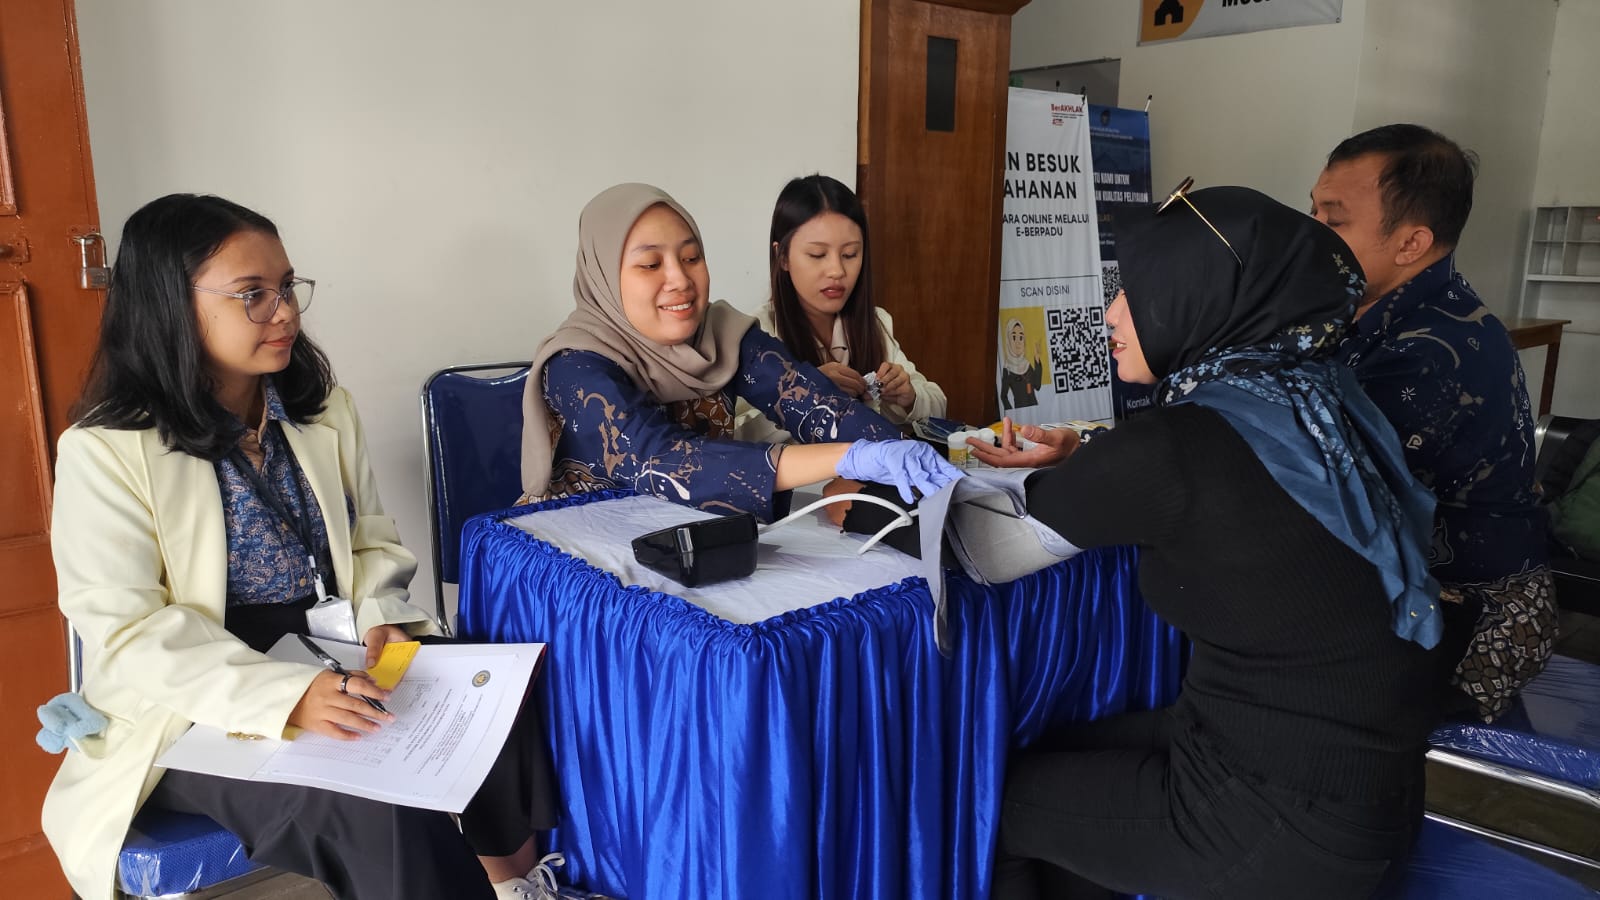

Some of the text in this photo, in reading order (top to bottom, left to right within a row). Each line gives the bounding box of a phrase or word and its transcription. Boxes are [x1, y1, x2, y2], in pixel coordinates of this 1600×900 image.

[1051, 104, 1083, 113] BerAKHLAK
[1005, 151, 1081, 173] N BESUK
[1004, 179, 1077, 199] AHANAN
[1021, 214, 1053, 224] ONLINE
[1054, 214, 1090, 224] MELALUI
[1016, 226, 1063, 237] E-BERPADU
[1020, 284, 1070, 298] SCAN DISINI
[1126, 395, 1151, 409] Kontak
